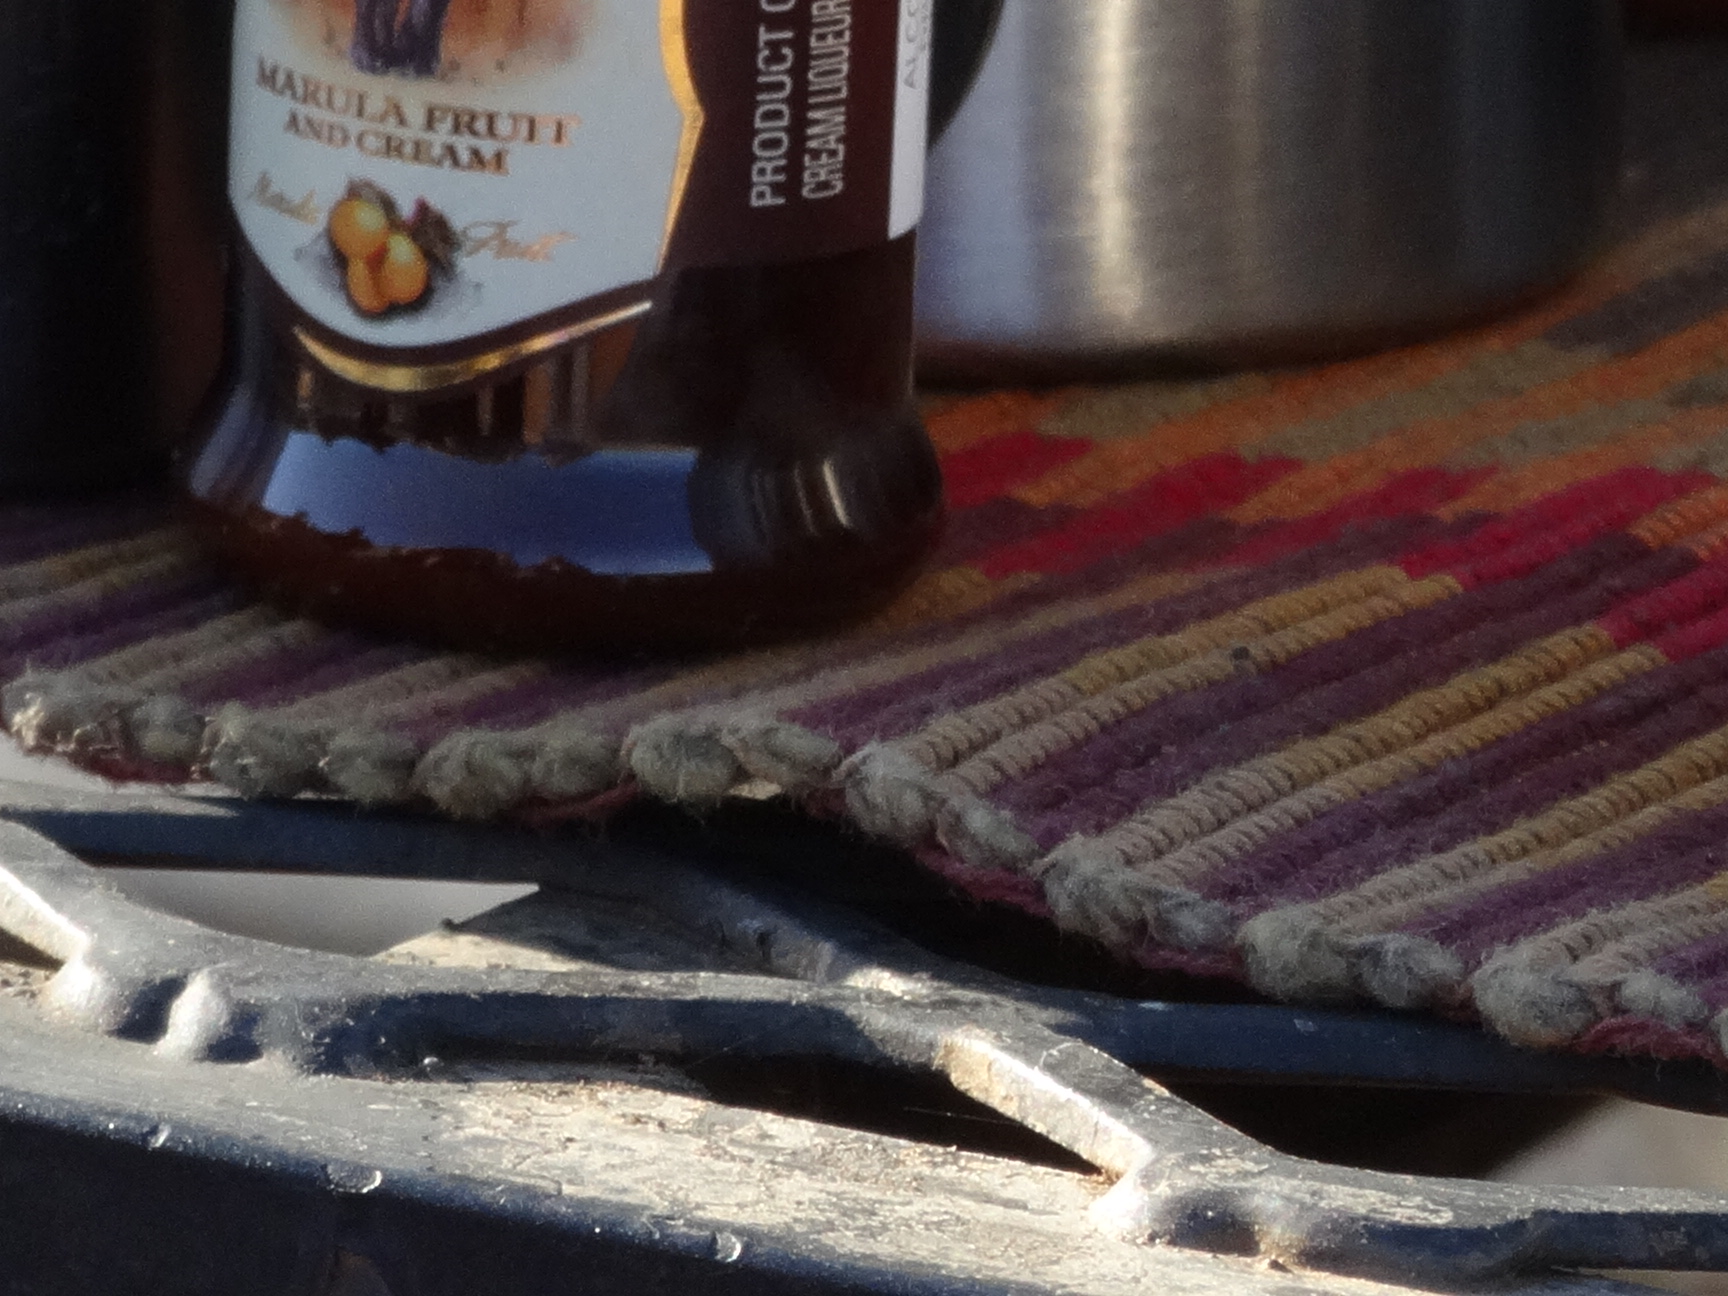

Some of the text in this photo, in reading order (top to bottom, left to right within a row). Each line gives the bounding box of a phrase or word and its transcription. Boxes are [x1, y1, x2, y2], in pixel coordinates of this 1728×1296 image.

[255, 53, 582, 148] MARULA FRUIT
[283, 110, 510, 176] AND CREAM
[750, 25, 796, 207] PRODUCT
[803, 107, 845, 198] CREAM
